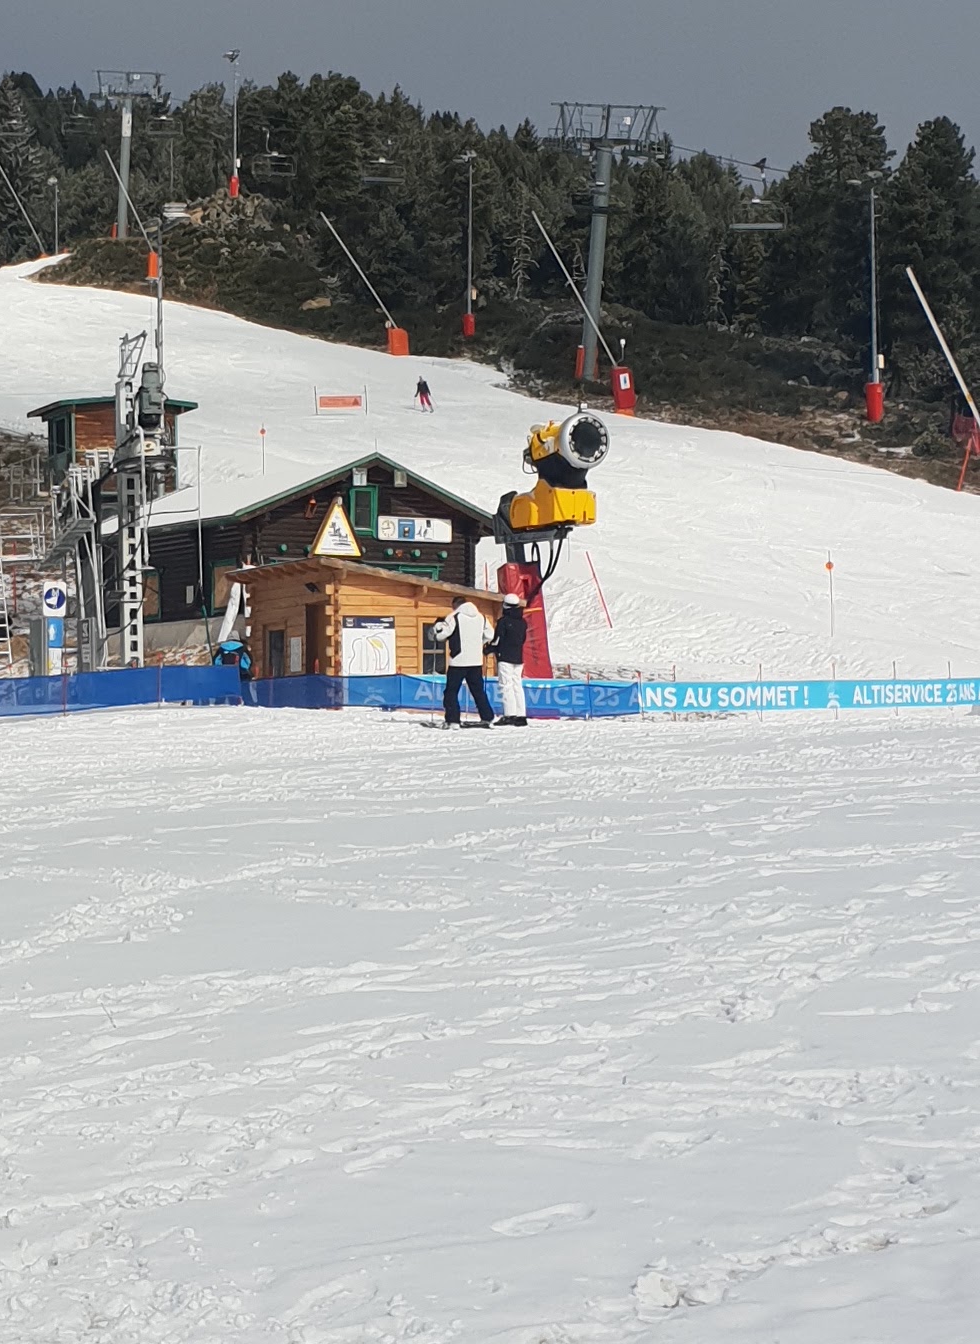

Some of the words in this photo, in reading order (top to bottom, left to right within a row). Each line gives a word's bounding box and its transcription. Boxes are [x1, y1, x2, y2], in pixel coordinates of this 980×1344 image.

[593, 686, 620, 707] 25
[628, 686, 678, 708] ANS
[683, 687, 712, 707] AU
[717, 685, 799, 706] SOMMET
[803, 685, 810, 706] !
[853, 683, 943, 705] ALTISERVICE
[959, 682, 977, 701] ANS
